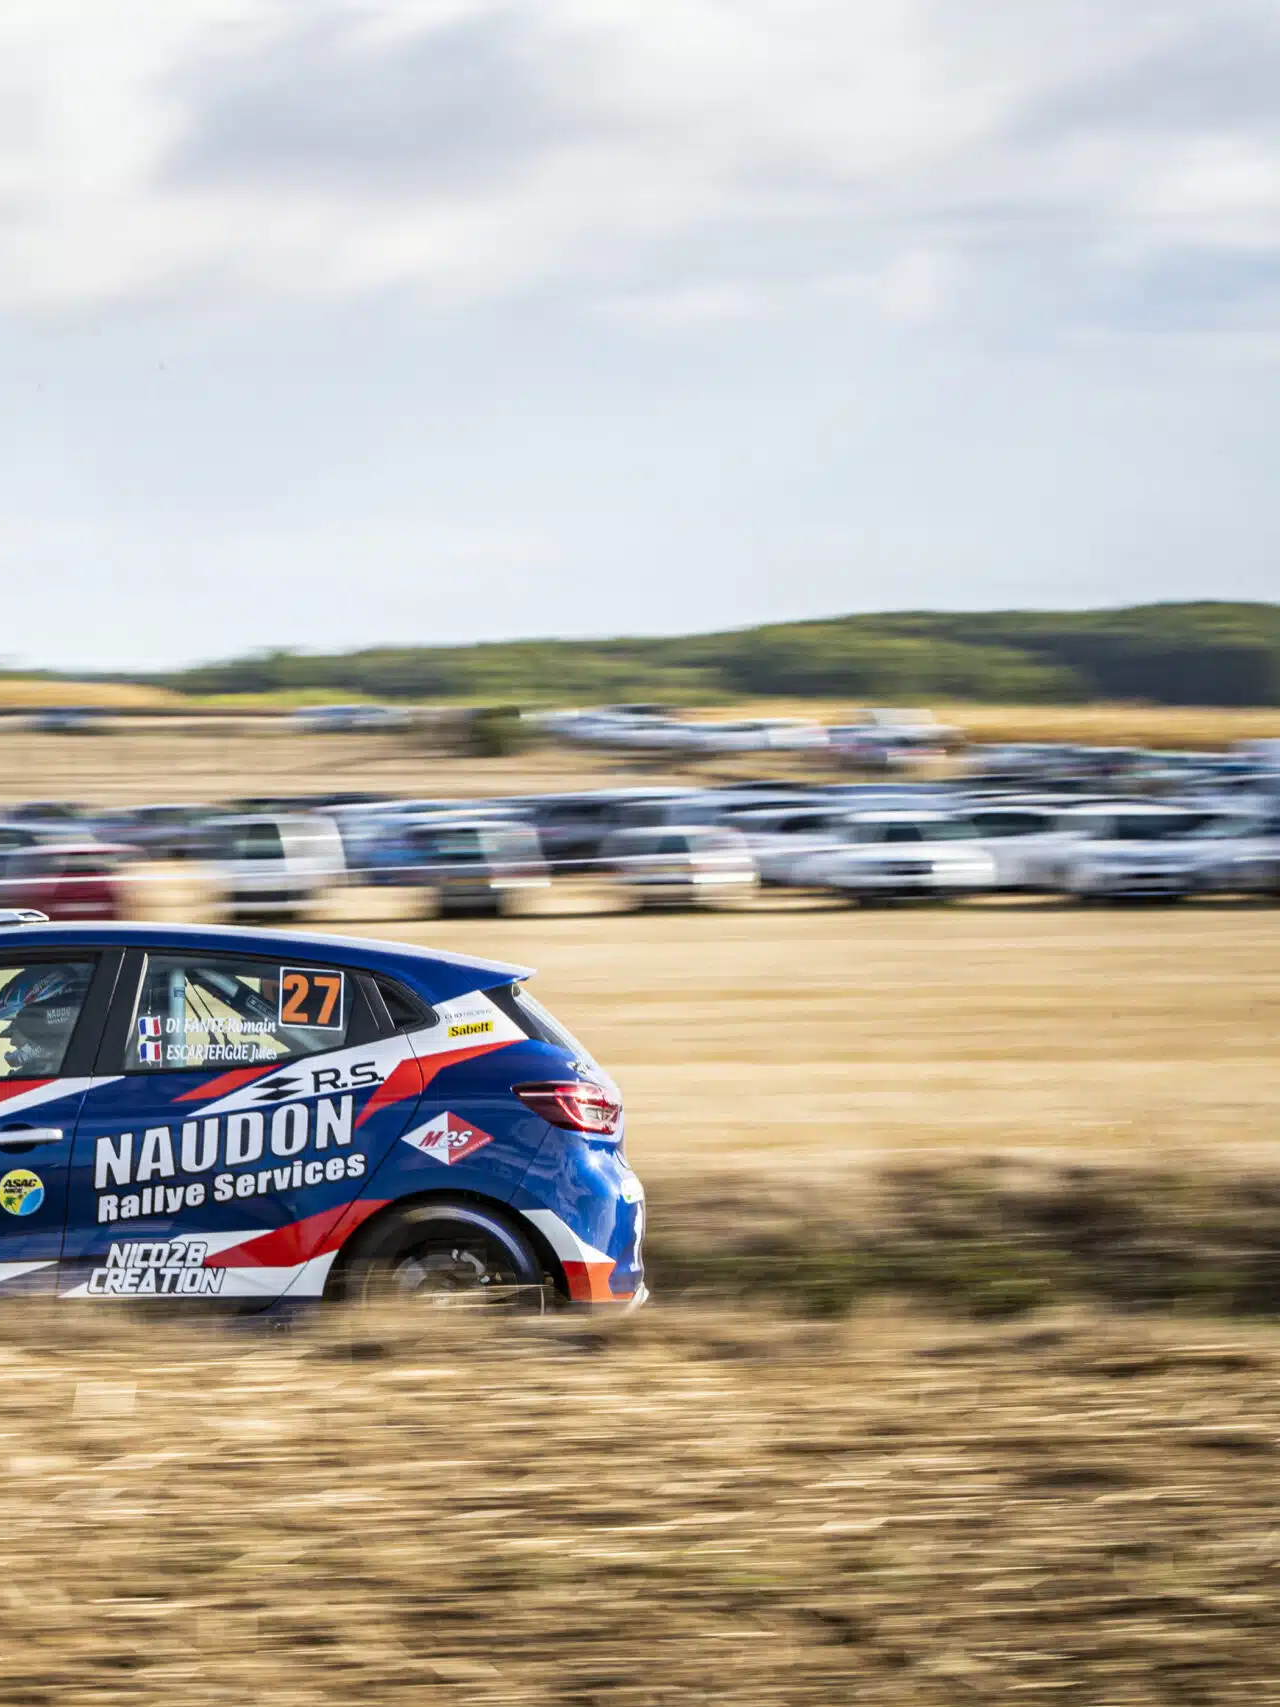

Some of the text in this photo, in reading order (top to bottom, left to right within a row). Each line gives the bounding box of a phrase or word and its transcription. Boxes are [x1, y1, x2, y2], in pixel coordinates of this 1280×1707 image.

[282, 973, 341, 1025] 27
[451, 1021, 489, 1037] Sabelt
[312, 1061, 385, 1093] R.S.
[94, 1095, 354, 1190] NAUDON
[98, 1154, 366, 1223] Rallye Services
[87, 1267, 226, 1294] CREATION
